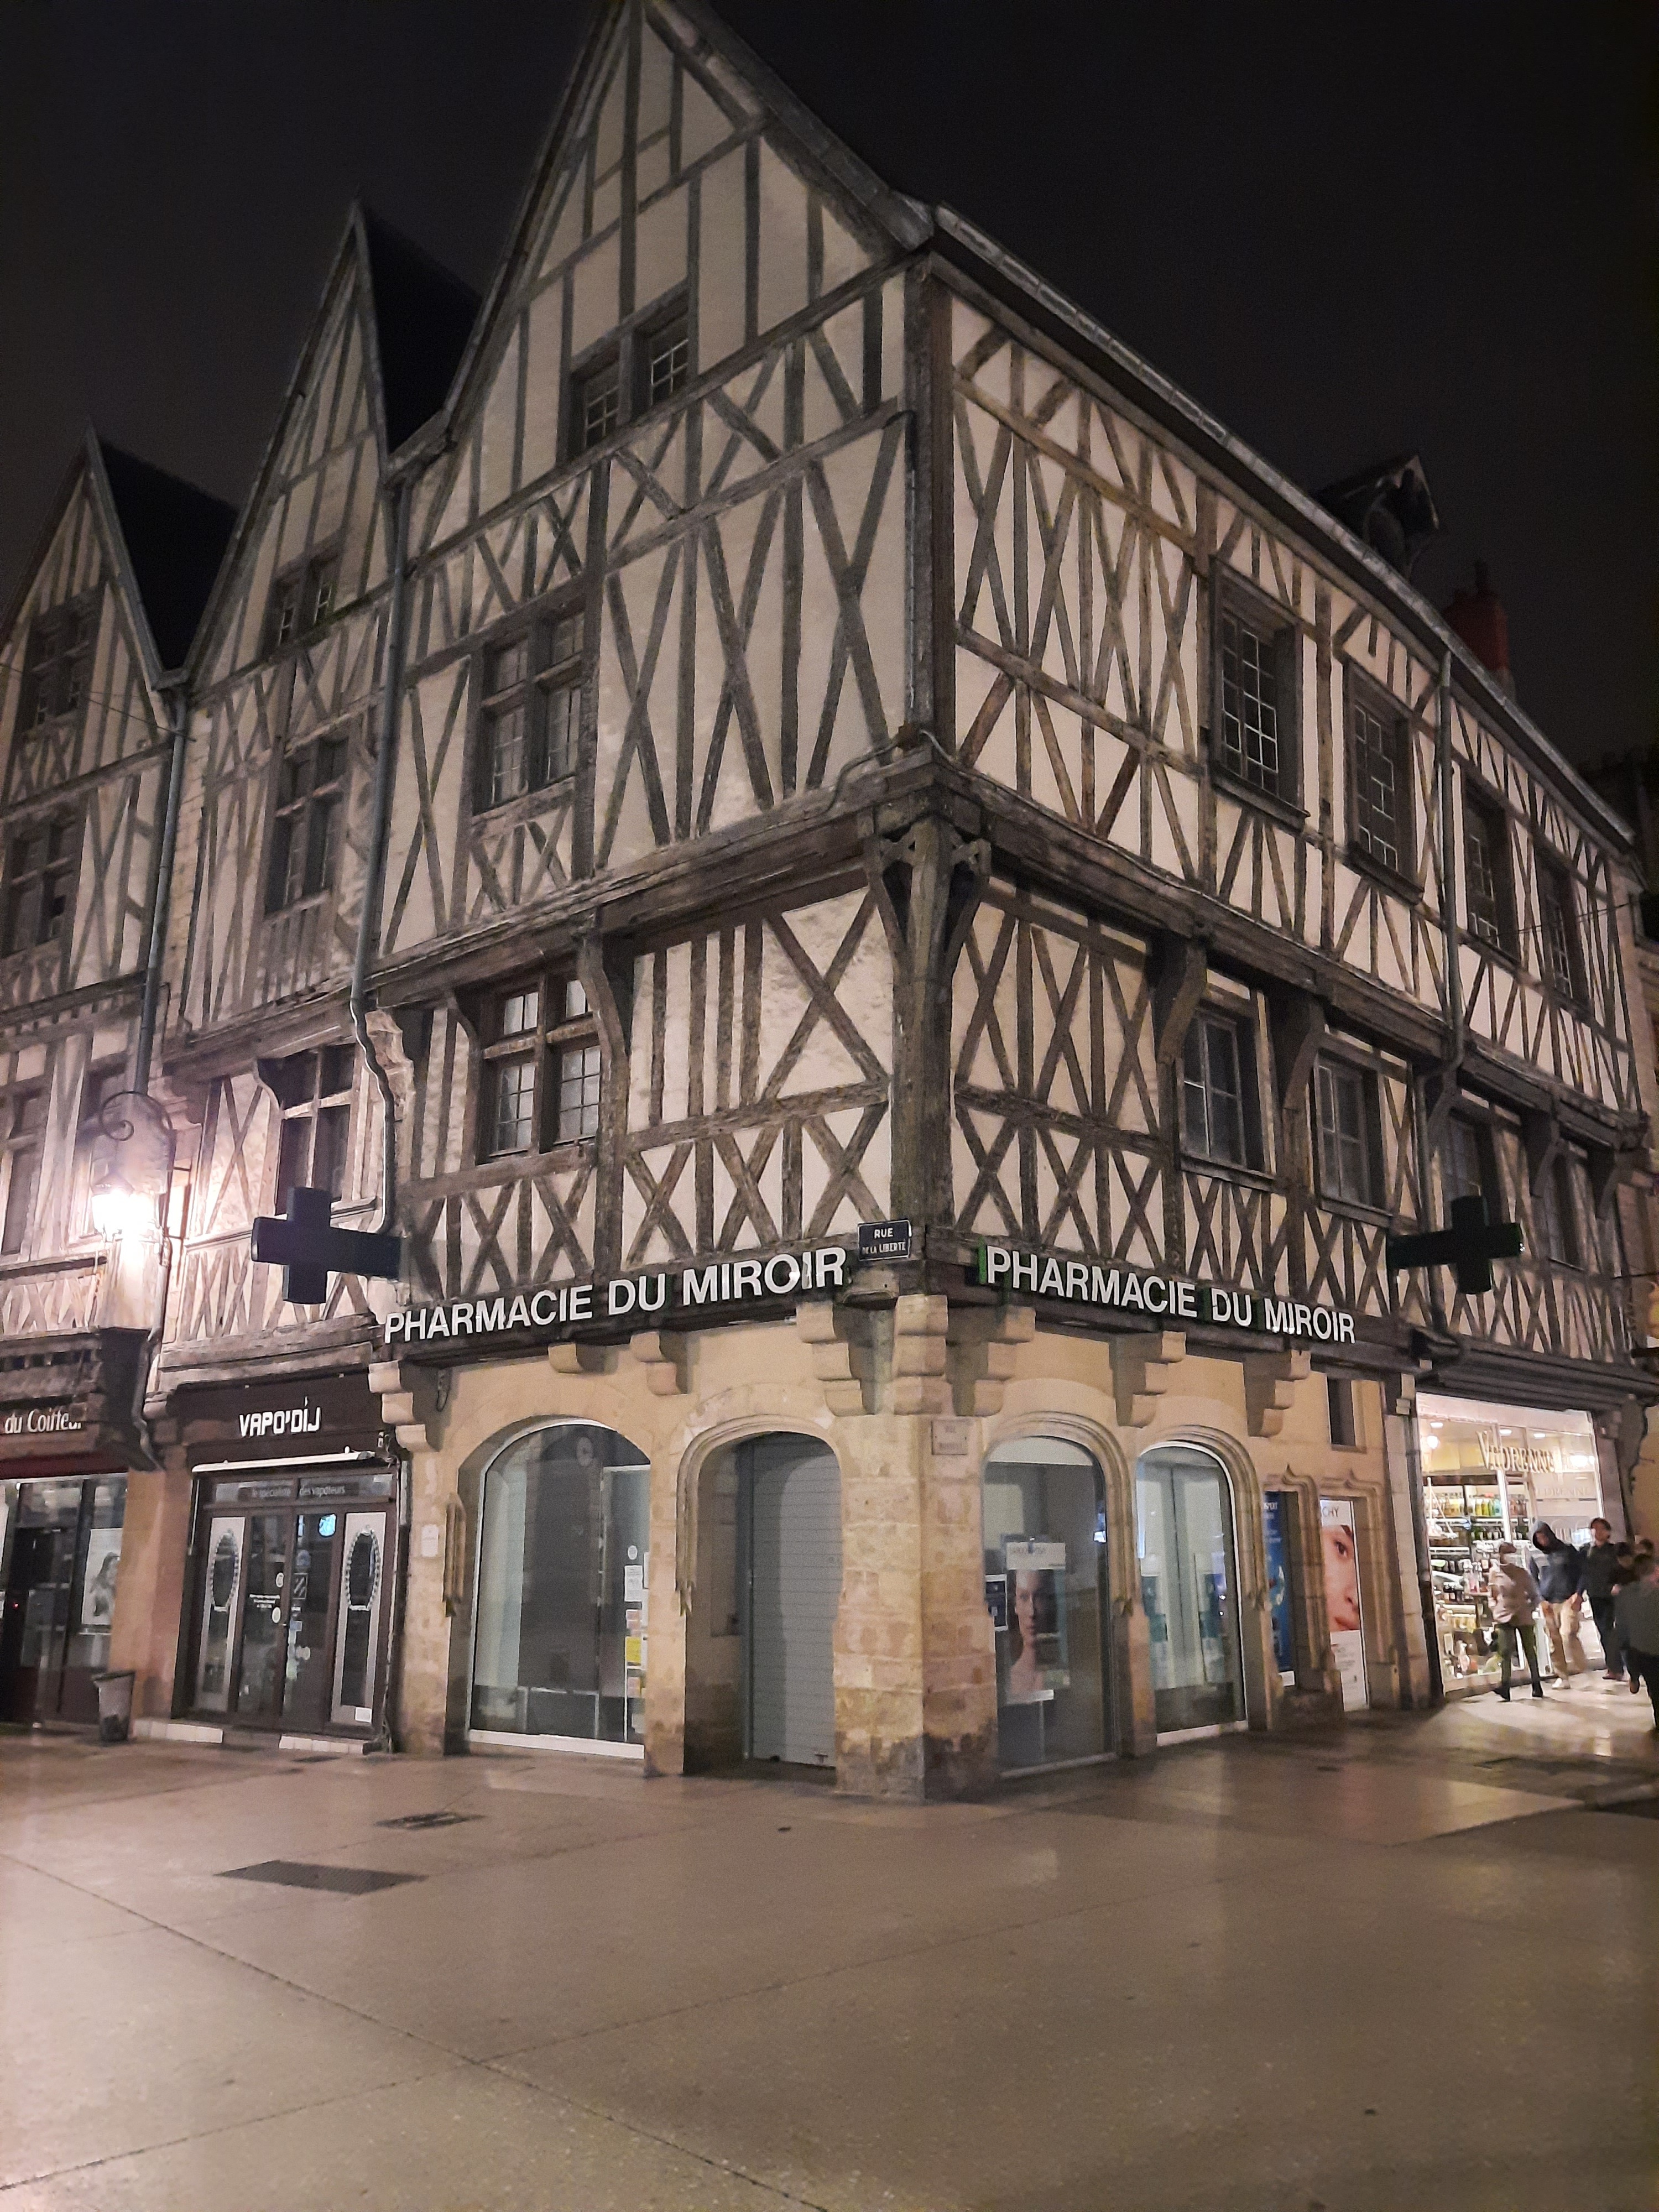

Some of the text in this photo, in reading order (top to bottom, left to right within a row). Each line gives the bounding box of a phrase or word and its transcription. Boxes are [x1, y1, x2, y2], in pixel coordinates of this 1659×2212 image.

[874, 1228, 894, 1238] RUE
[384, 1246, 847, 1344] PHARMACIE DU MIROIR
[987, 1245, 1355, 1344] PHARMACIE DU MIROIR
[4, 1412, 23, 1434] du
[1322, 1506, 1339, 1517] CHY
